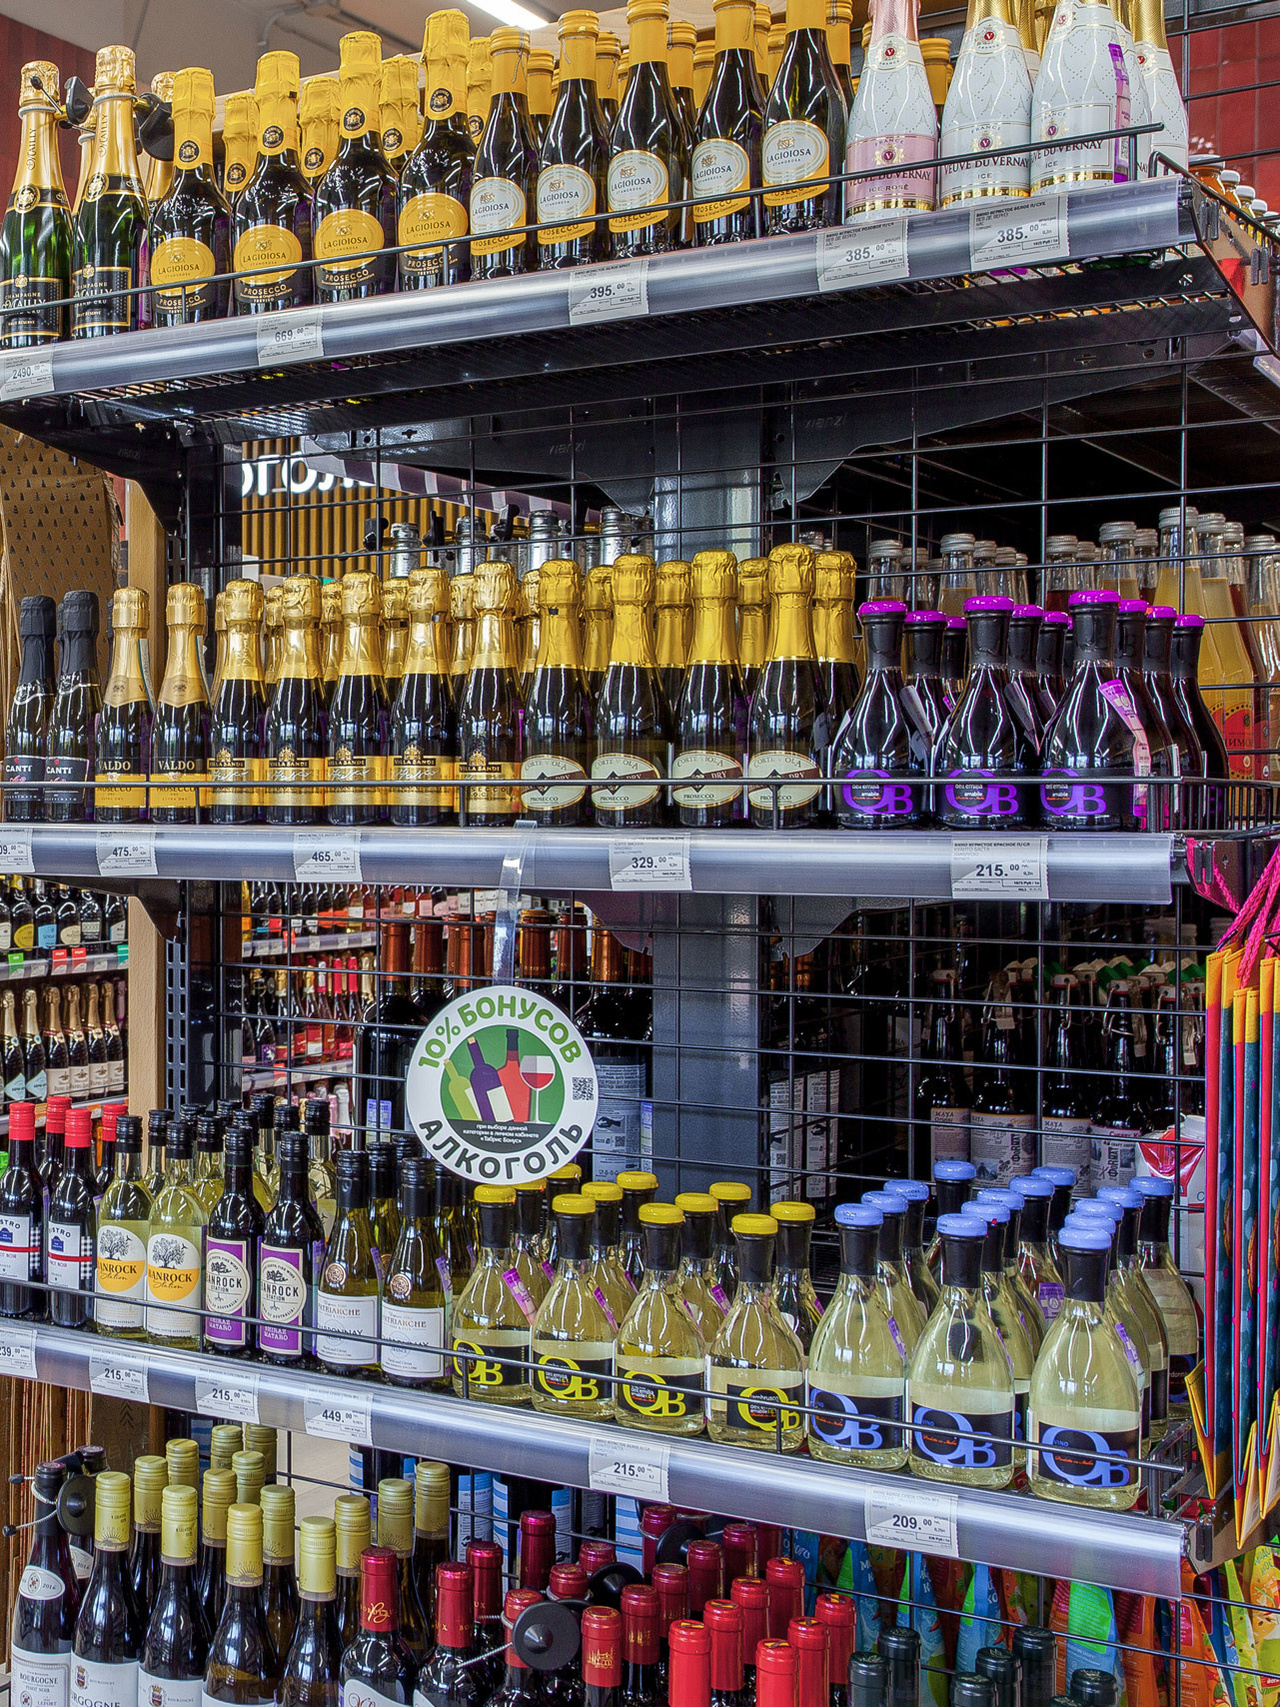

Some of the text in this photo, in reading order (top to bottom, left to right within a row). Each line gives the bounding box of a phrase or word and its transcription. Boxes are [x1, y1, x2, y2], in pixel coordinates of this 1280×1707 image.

[992, 152, 1030, 168] VERNAY
[997, 227, 1028, 243] 385.
[845, 247, 874, 263] 385.
[325, 269, 369, 283] PROSECCO
[244, 284, 286, 295] PROSECCO
[5, 765, 32, 773] CANTI
[46, 766, 72, 774] CANTI
[98, 760, 131, 770] VALDO
[158, 760, 195, 770] VALDO
[113, 846, 132, 857] 475.
[311, 851, 334, 862] 465.
[631, 856, 658, 869] 329.
[976, 864, 1008, 877] 215.
[418, 995, 581, 1069] 10% БОНУСОВ
[419, 1119, 583, 1180] АЛКОГОЛЬ
[101, 1272, 128, 1281] Station
[153, 1280, 183, 1289] Station
[453, 1338, 503, 1386] QB
[104, 1368, 124, 1381] 215.
[537, 1355, 599, 1401] QB
[212, 1388, 233, 1402] 215.
[622, 1370, 687, 1417] QB
[322, 1409, 345, 1423] 449.
[737, 1387, 800, 1431] QB
[810, 1388, 883, 1450] QB
[913, 1405, 996, 1468] QB
[1042, 1426, 1129, 1488] QB
[613, 1462, 639, 1478] 215.
[892, 1514, 922, 1531] 209.
[20, 1673, 58, 1685] BOURGOGNE
